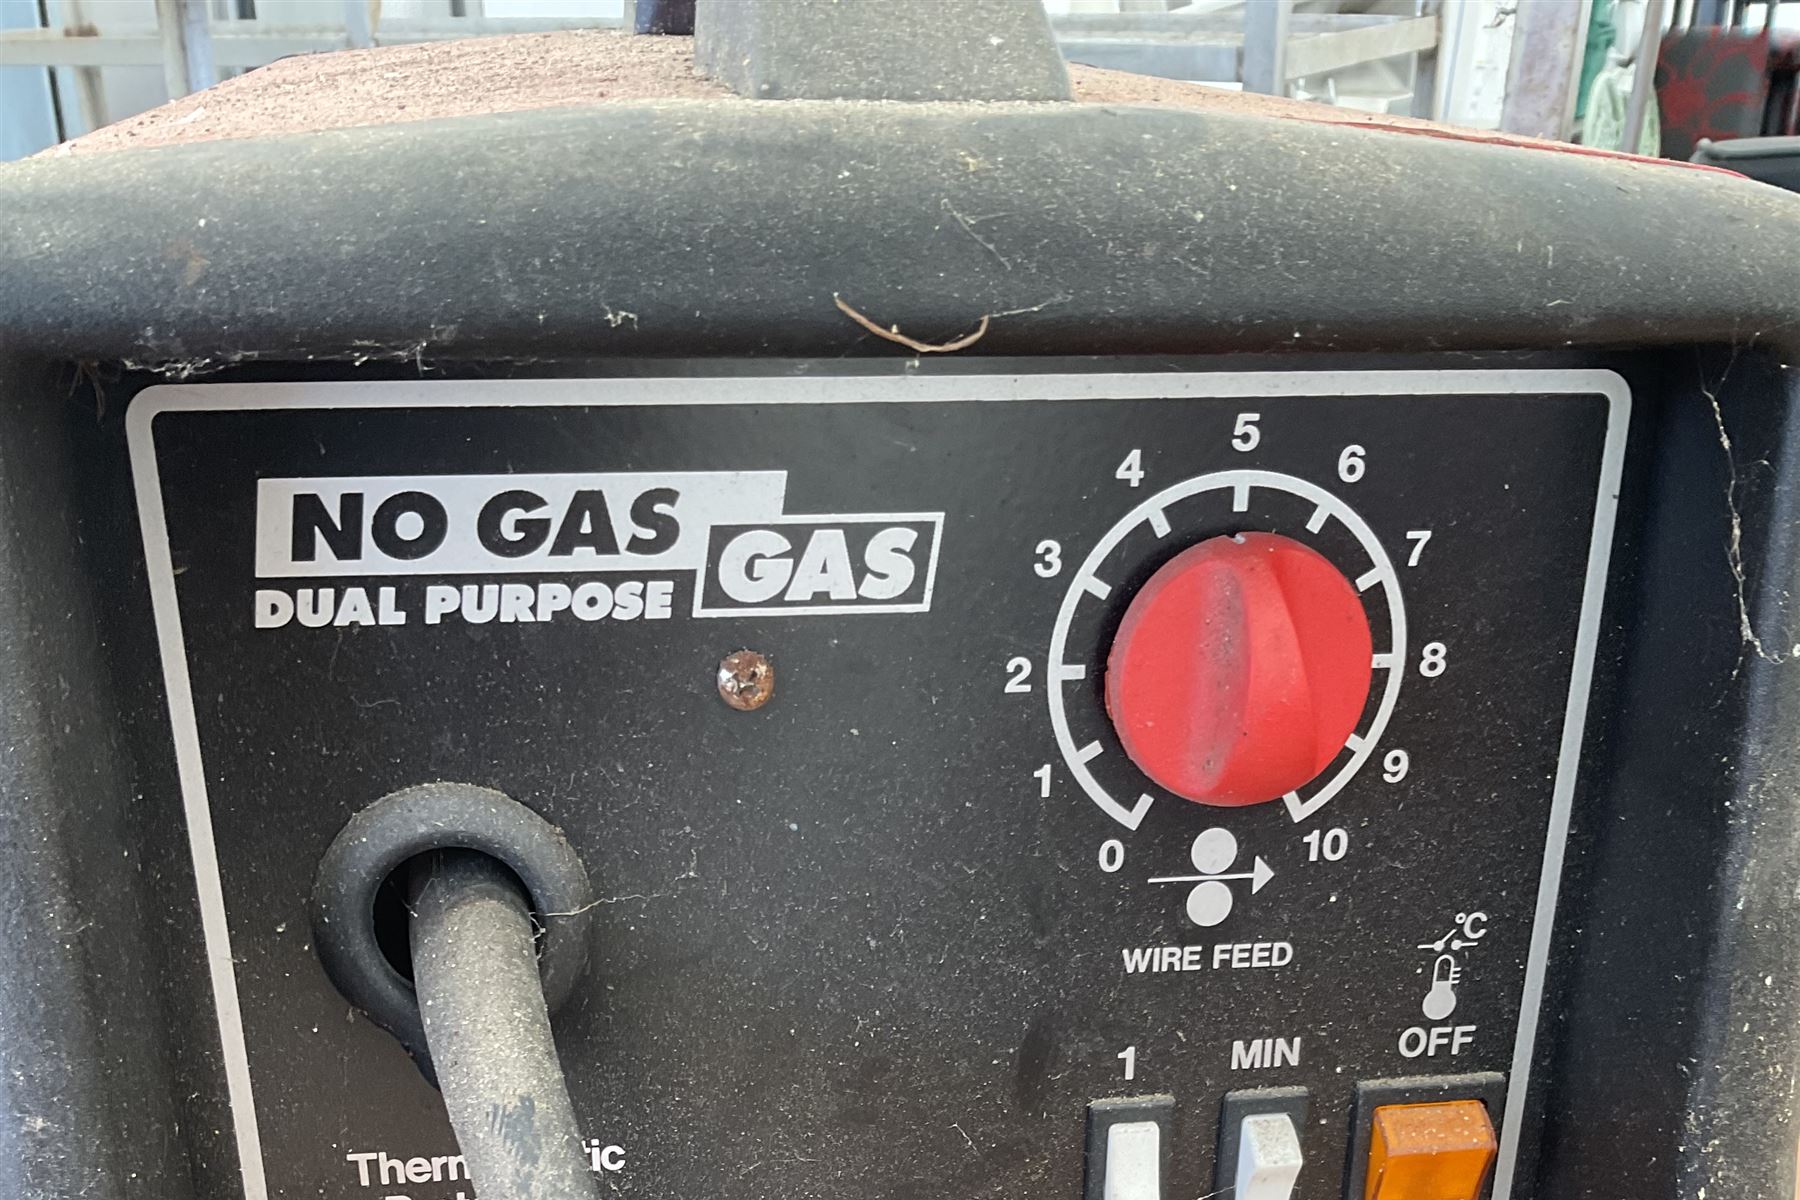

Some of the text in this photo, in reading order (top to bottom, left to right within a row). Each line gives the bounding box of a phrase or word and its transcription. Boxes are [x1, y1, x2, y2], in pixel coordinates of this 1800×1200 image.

[1231, 413, 1261, 452] 5
[1115, 449, 1145, 487] 4
[1337, 445, 1366, 483] 6
[291, 488, 681, 562] NO GAS
[718, 528, 917, 602] GAS
[1033, 540, 1062, 578] 3
[1405, 530, 1432, 567] 7
[255, 581, 673, 629] DUAL PURPOSE
[1004, 657, 1032, 693] 2
[1419, 642, 1447, 677] 8
[1033, 765, 1052, 798] 1
[1382, 749, 1410, 783] 9
[1098, 839, 1125, 872] 0
[1302, 827, 1349, 862] 10
[1122, 941, 1294, 974] WIRE FEED
[1231, 1037, 1301, 1071] MIN
[1398, 1025, 1477, 1058] OFF
[1117, 1046, 1136, 1081] 1
